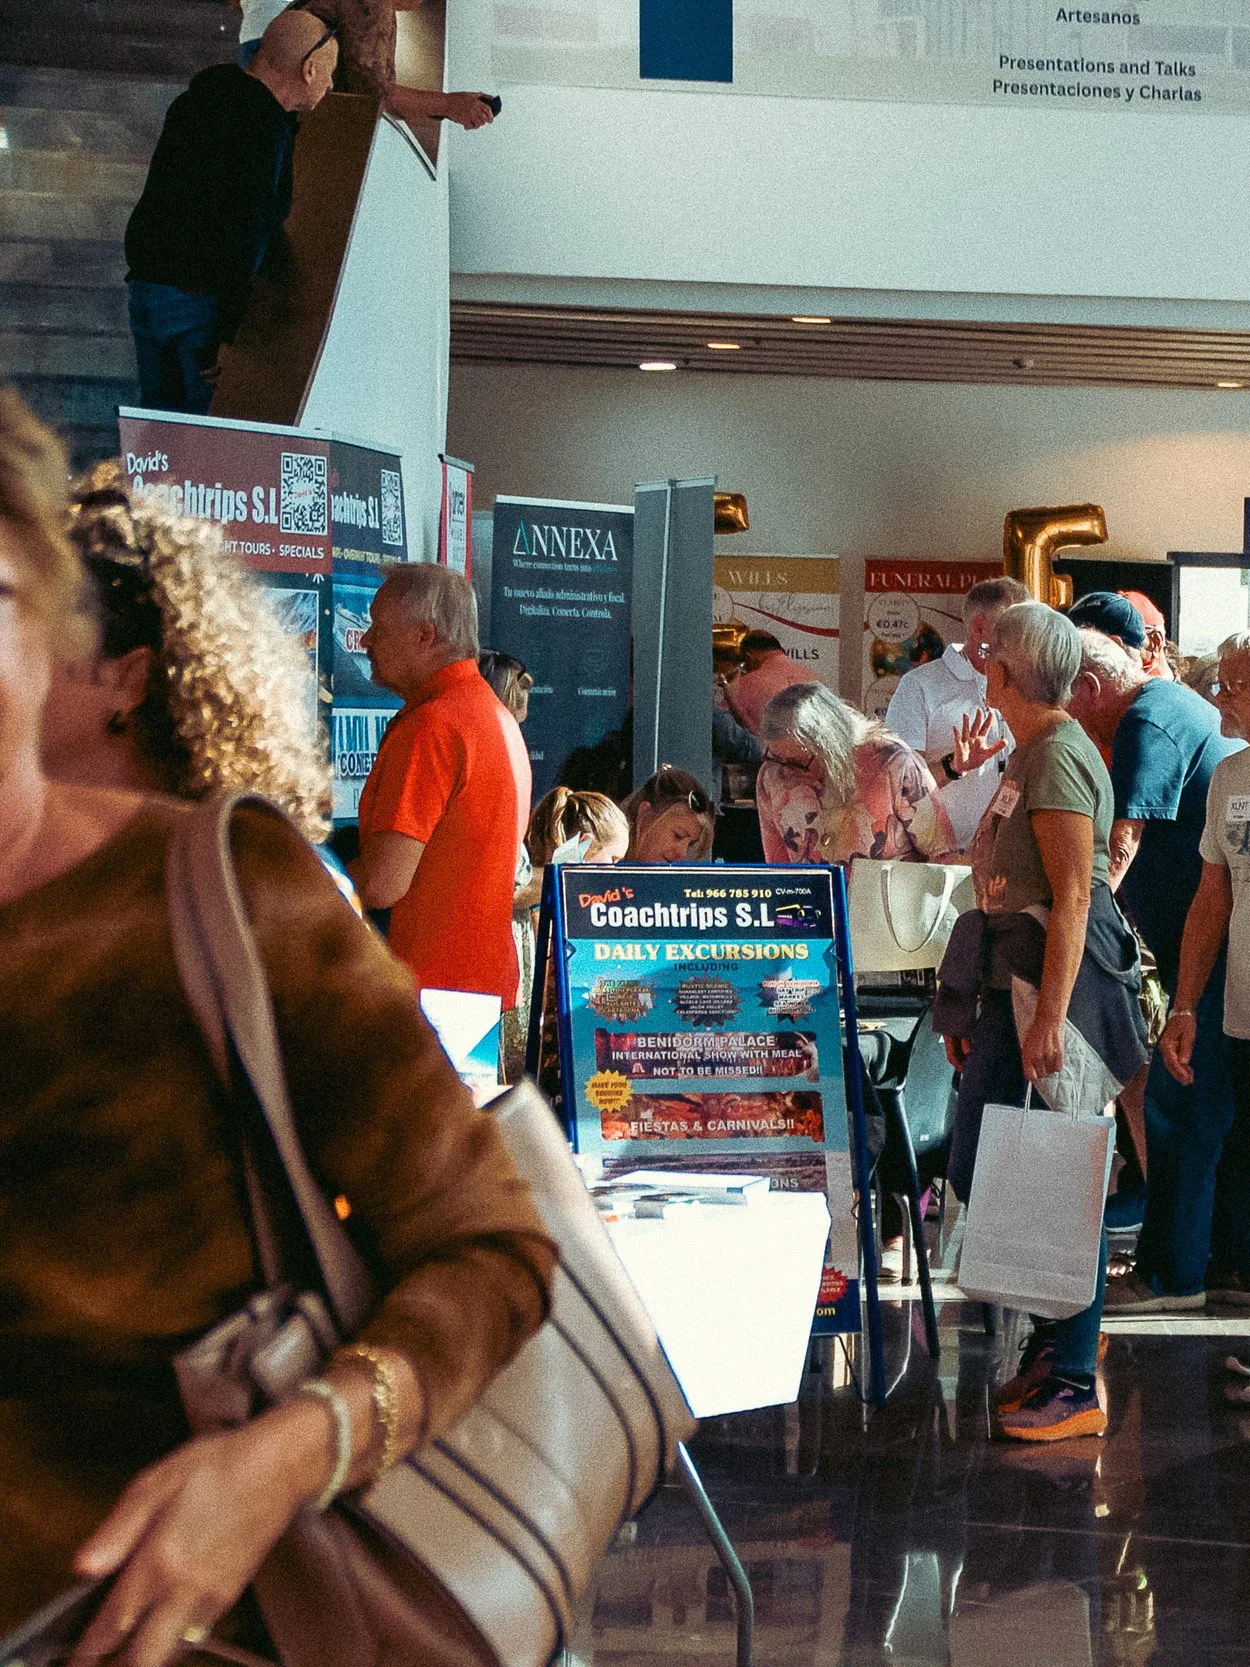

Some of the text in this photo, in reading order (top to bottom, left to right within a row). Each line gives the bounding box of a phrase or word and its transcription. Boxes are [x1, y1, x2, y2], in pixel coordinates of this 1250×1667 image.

[1055, 7, 1141, 25] Artesanos
[999, 55, 1197, 77] Presentations and Talks
[992, 79, 1203, 103] Presentaciones y Charlas
[126, 450, 169, 475] David's
[252, 485, 279, 525] S.L
[513, 519, 619, 562] ANNEXA
[279, 544, 324, 559] SPECIALS
[728, 570, 788, 586] WILLS
[870, 571, 956, 588] FUNERAL
[684, 888, 773, 899] Tel: 966 785 910
[590, 902, 776, 931] Coachtrips S.L
[594, 943, 809, 961] DAILY EXCURSIONS
[673, 962, 740, 972] INCLUDING
[637, 1035, 776, 1049] BENIDORM PALACE
[612, 1049, 803, 1061] INTERNATIONAL SHOW WITH MEAL
[653, 1066, 763, 1076] NOT TO BE MISSED!!
[630, 1118, 795, 1133] FIESTAS & CARNIVALS!!
